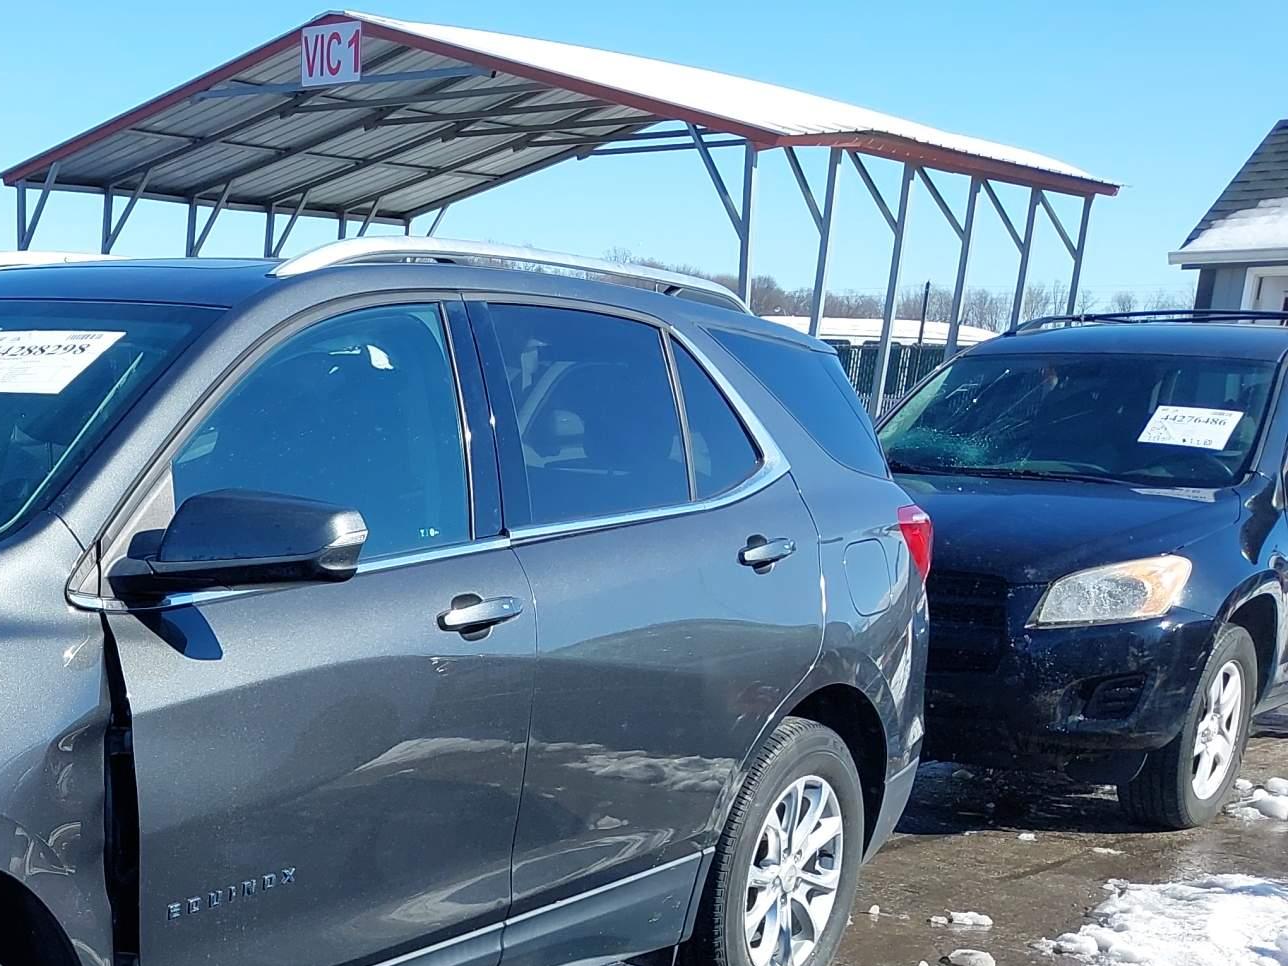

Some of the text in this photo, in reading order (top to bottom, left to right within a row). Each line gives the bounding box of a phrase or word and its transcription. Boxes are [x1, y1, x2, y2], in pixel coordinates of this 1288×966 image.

[303, 28, 360, 78] VIC 1
[1160, 413, 1227, 426] 44276486
[167, 866, 296, 921] EQUINOX
